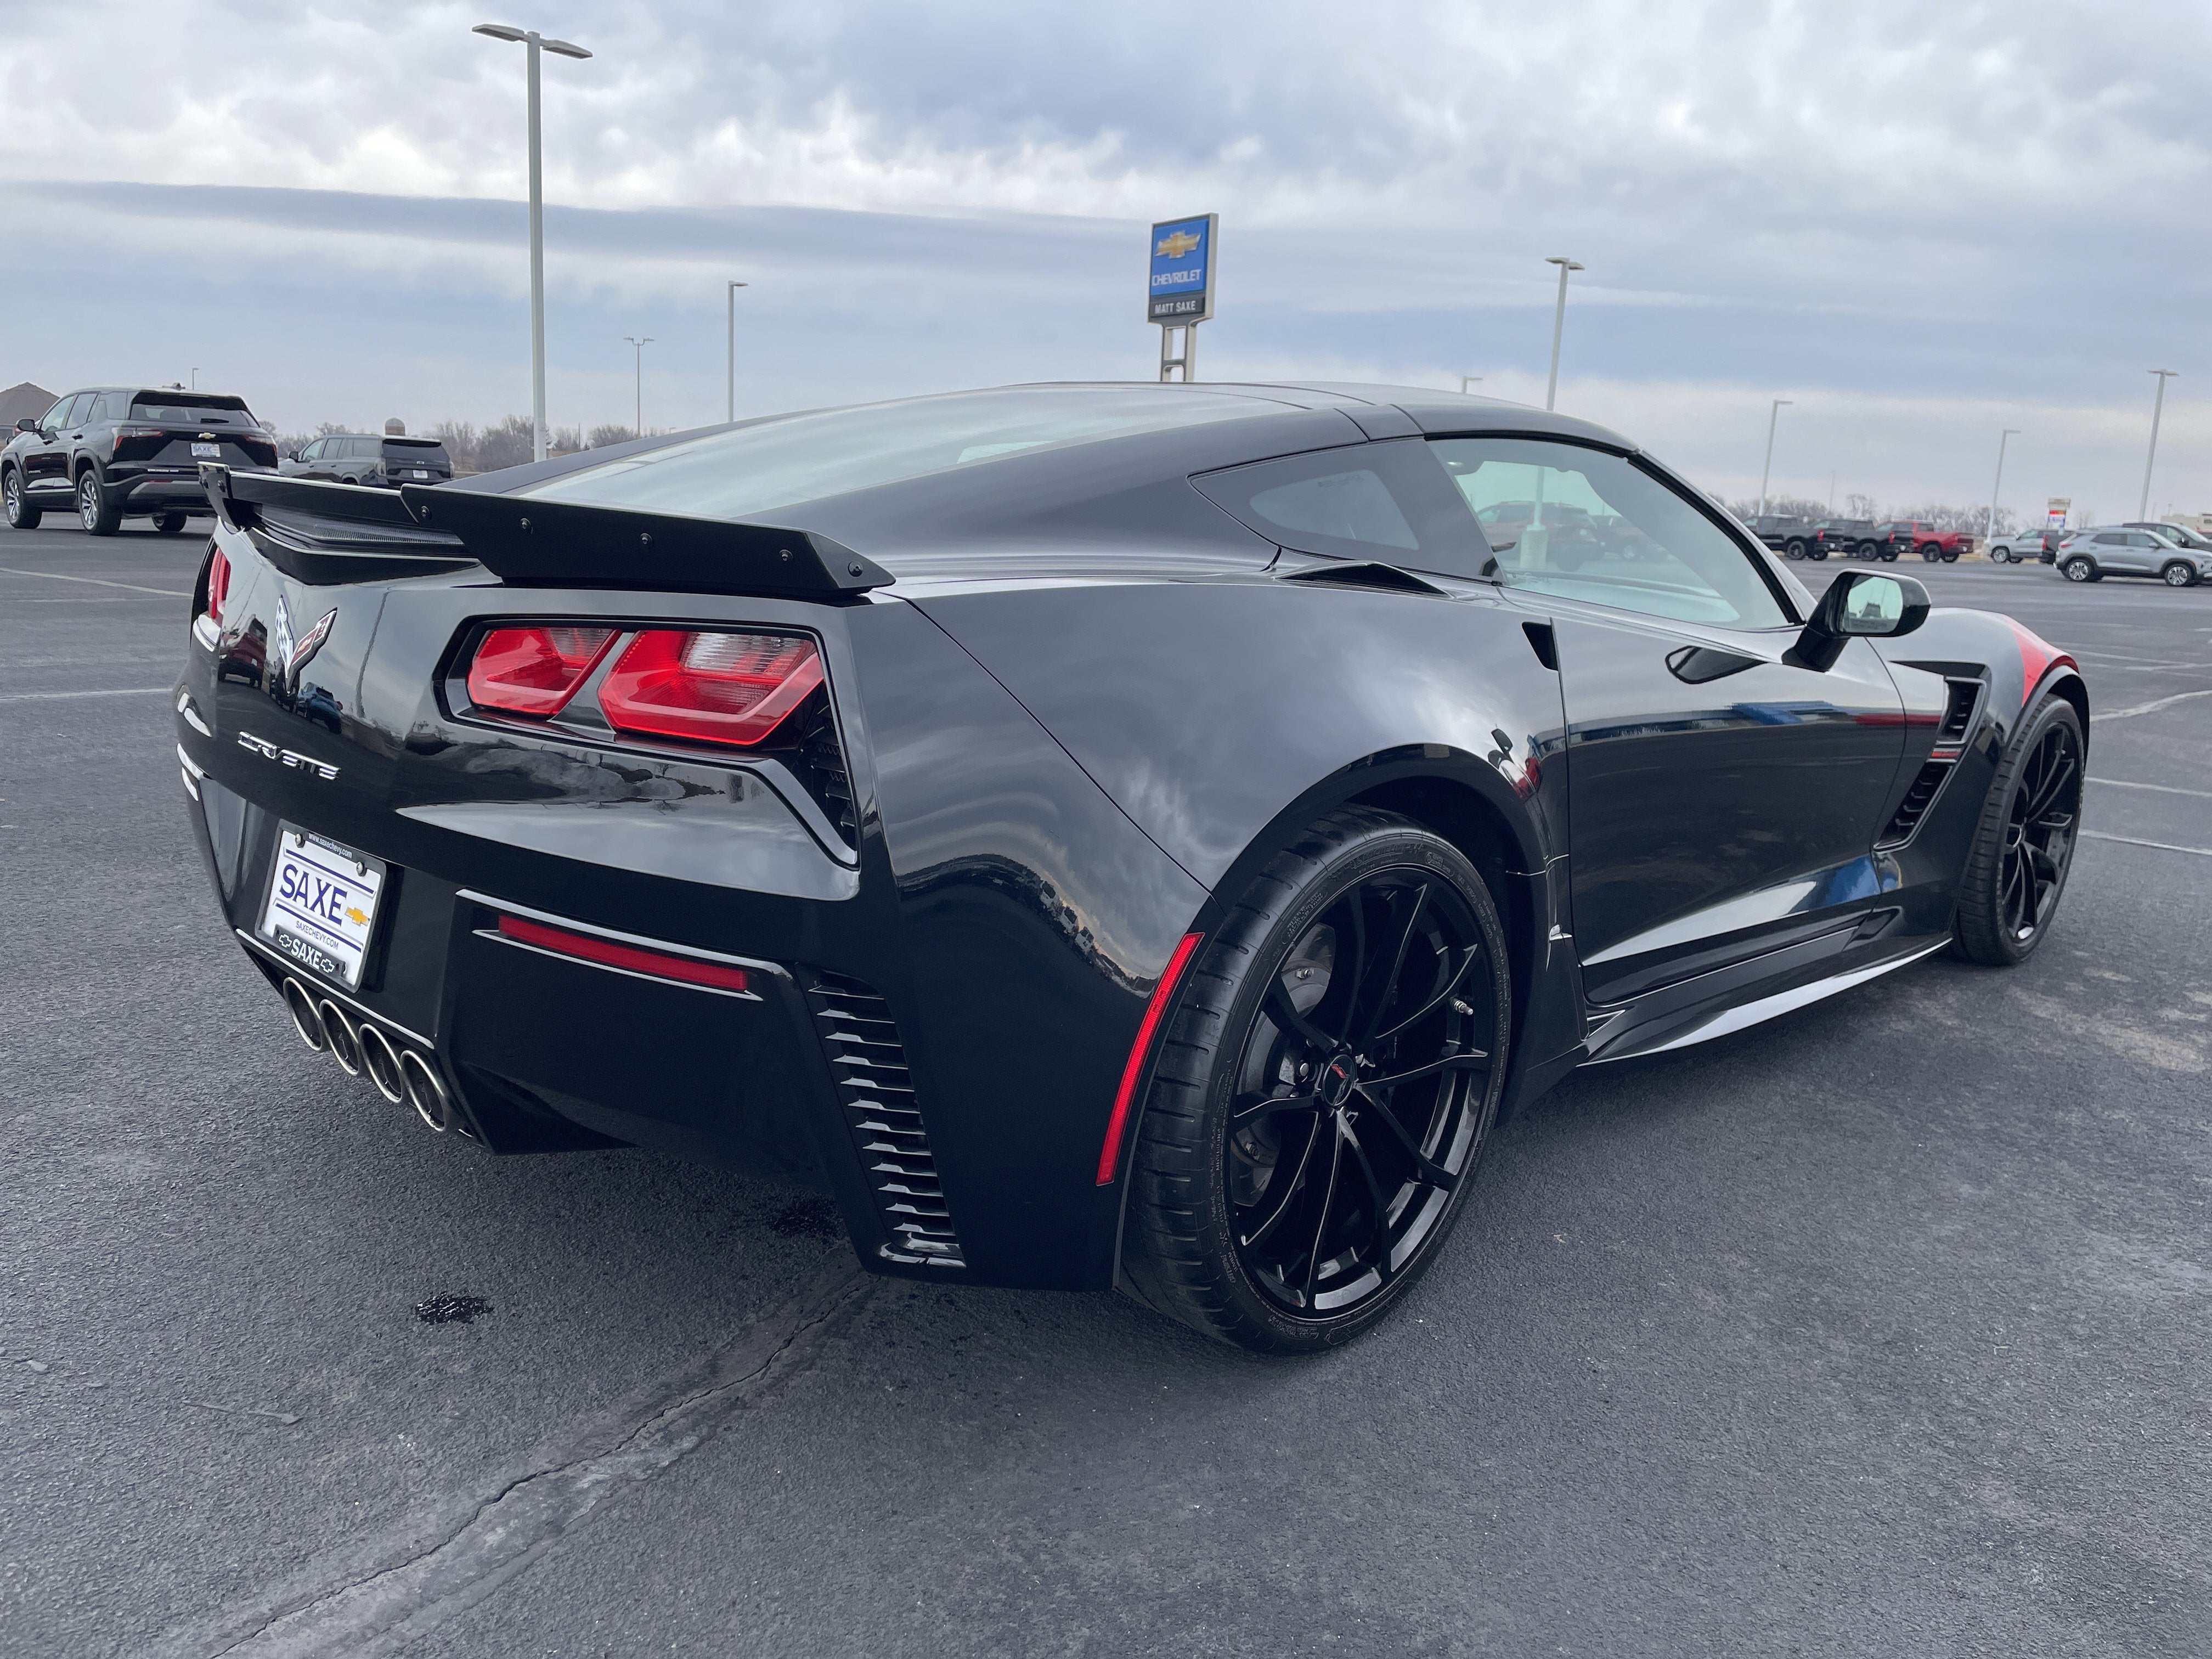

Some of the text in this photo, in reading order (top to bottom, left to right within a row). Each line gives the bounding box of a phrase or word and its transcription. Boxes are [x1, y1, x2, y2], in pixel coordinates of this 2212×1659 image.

[1152, 269, 1201, 286] CHEVROLET
[1155, 301, 1196, 314] MATT SAXE
[308, 832, 352, 859] www.saxechevy.com
[279, 864, 348, 927] SAXE
[296, 921, 339, 950] SAXECHEVY.COM
[291, 938, 323, 970] SAXE
